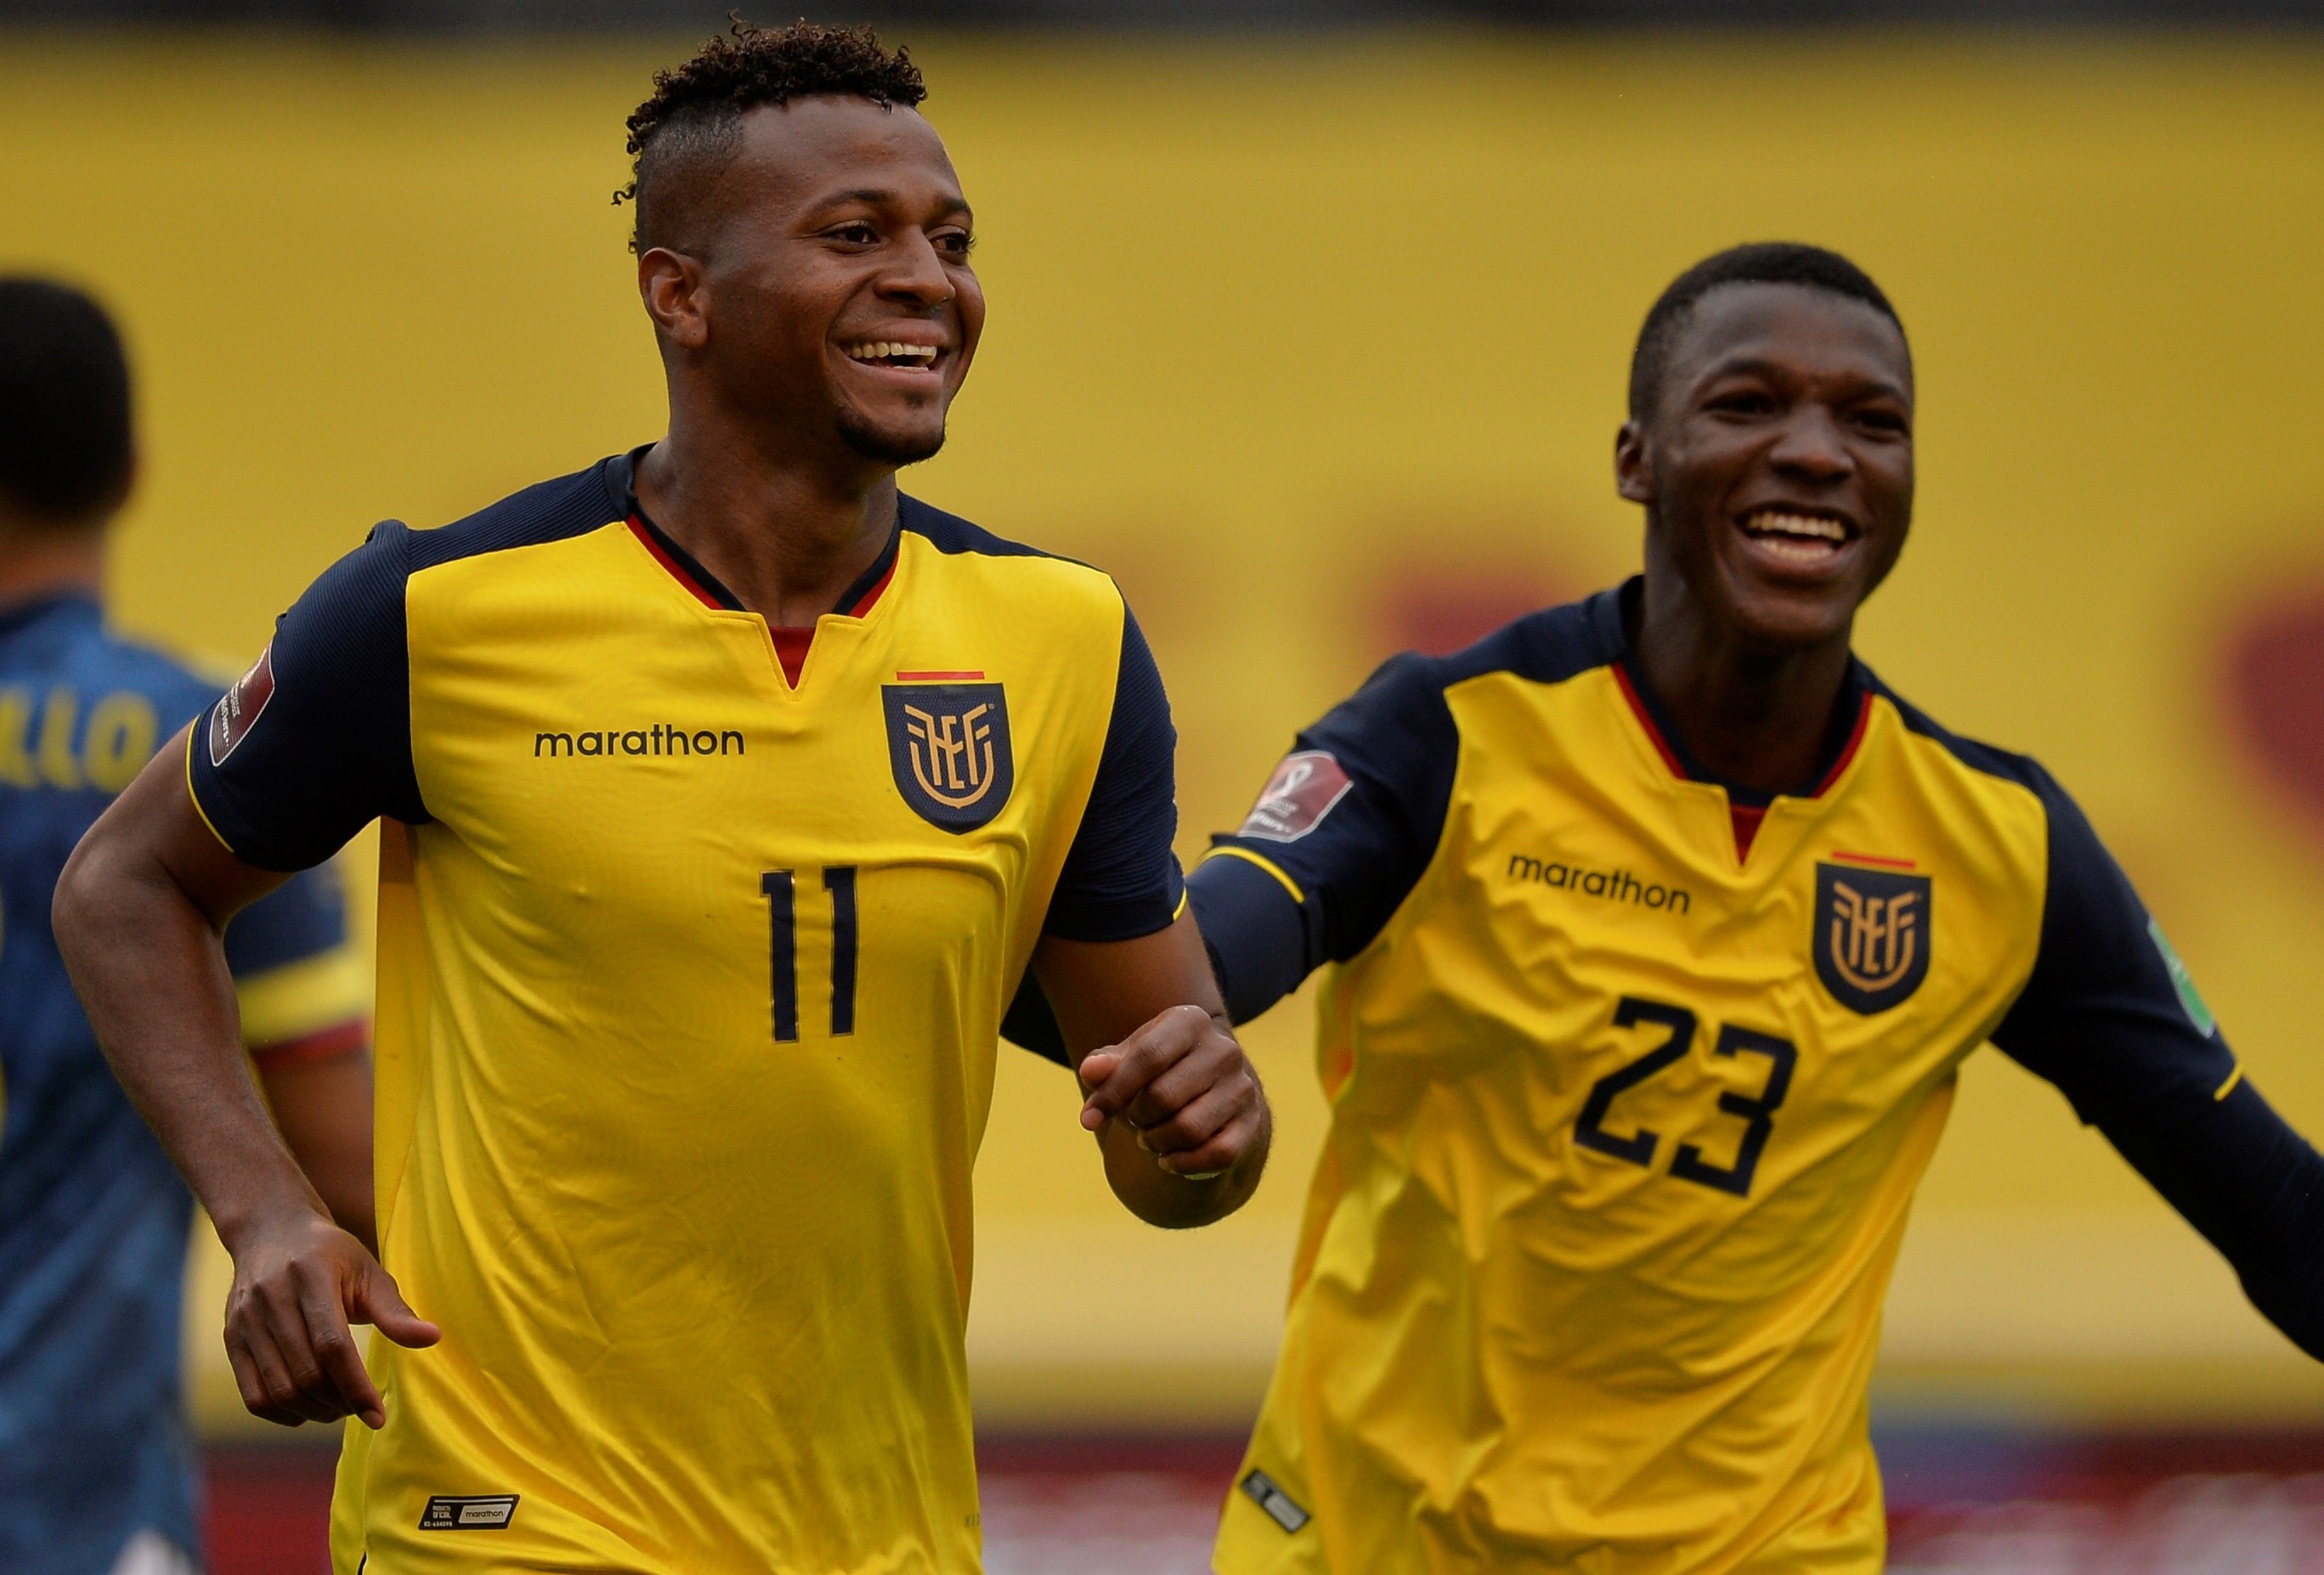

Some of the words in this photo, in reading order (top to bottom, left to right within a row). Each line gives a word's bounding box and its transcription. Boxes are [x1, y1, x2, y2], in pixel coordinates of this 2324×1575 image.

[534, 724, 744, 757] marathon
[1508, 855, 1690, 914] marathon
[761, 865, 858, 1044] 11
[1573, 995, 1799, 1200] 23
[466, 1510, 504, 1518] marathon
